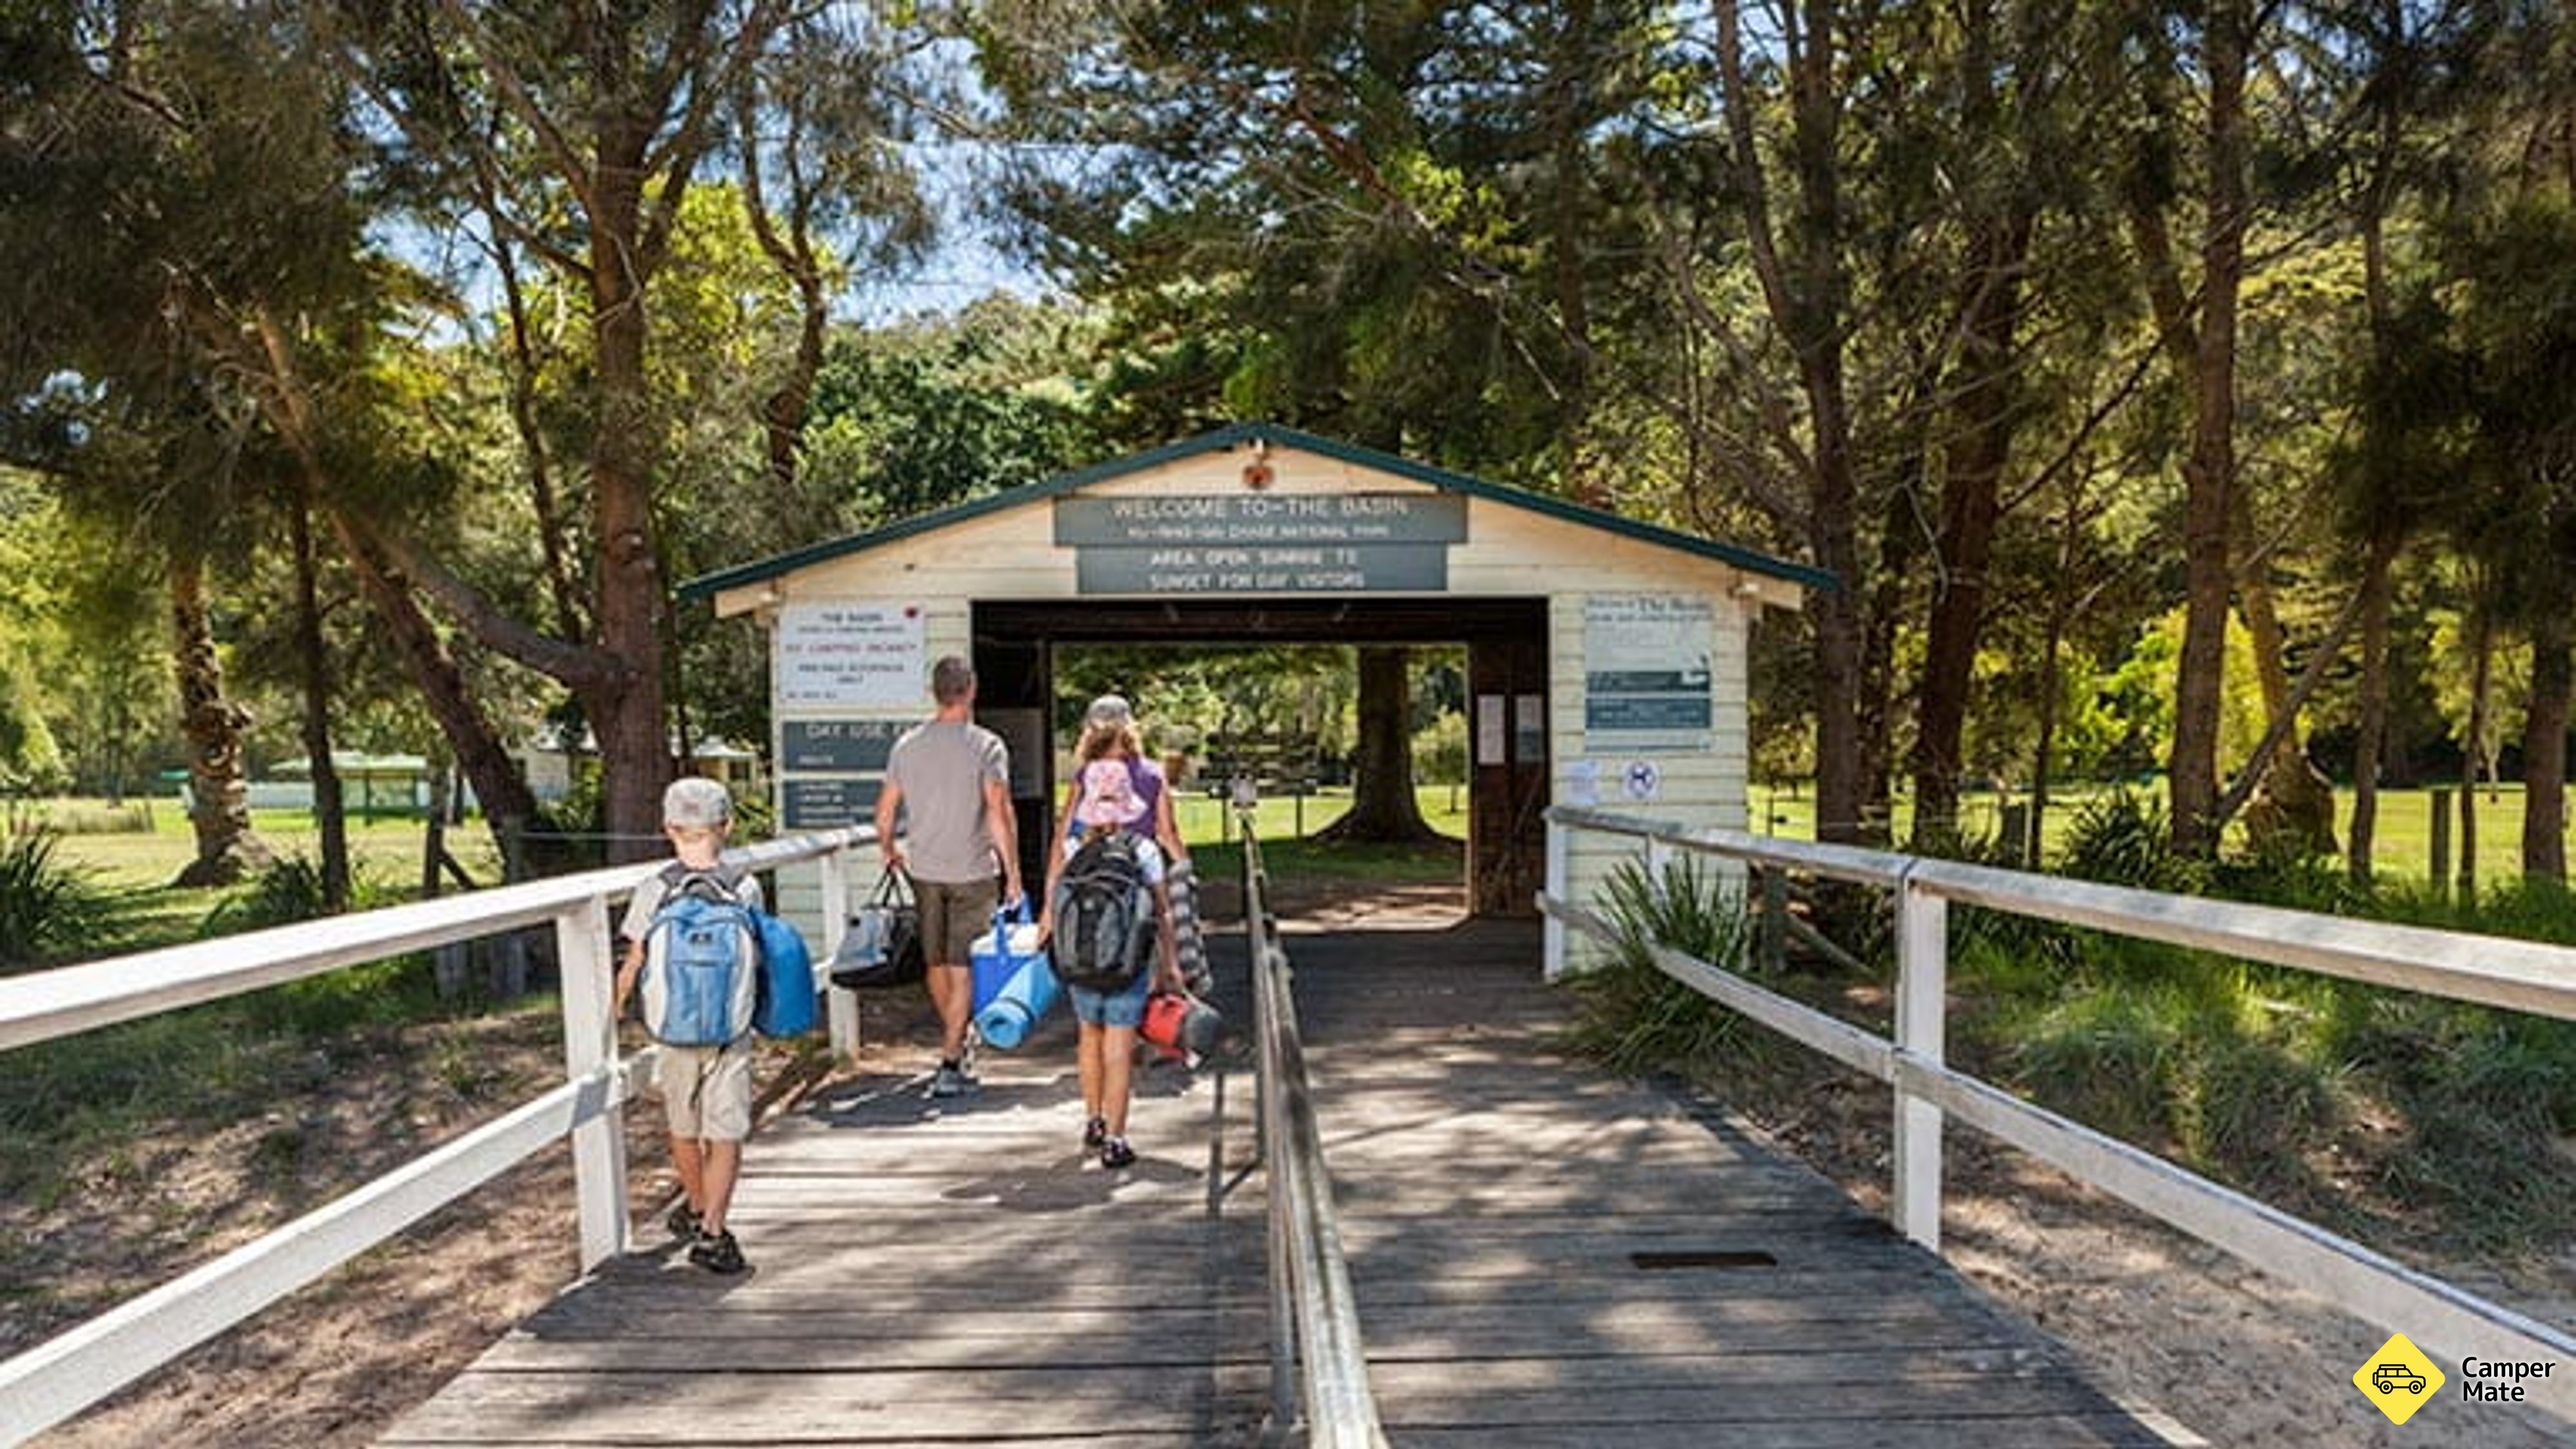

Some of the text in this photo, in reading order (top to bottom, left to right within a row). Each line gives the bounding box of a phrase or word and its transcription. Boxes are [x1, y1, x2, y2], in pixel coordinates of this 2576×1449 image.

[1112, 498, 1227, 517] WELCOME
[1341, 498, 1409, 516] BASIN
[1150, 551, 1196, 565] AREA
[1205, 550, 1249, 565] OPEN
[1150, 573, 1211, 590] SUNSET
[1218, 573, 1255, 589] FOR
[805, 724, 842, 739] DAY
[849, 724, 884, 739] USE
